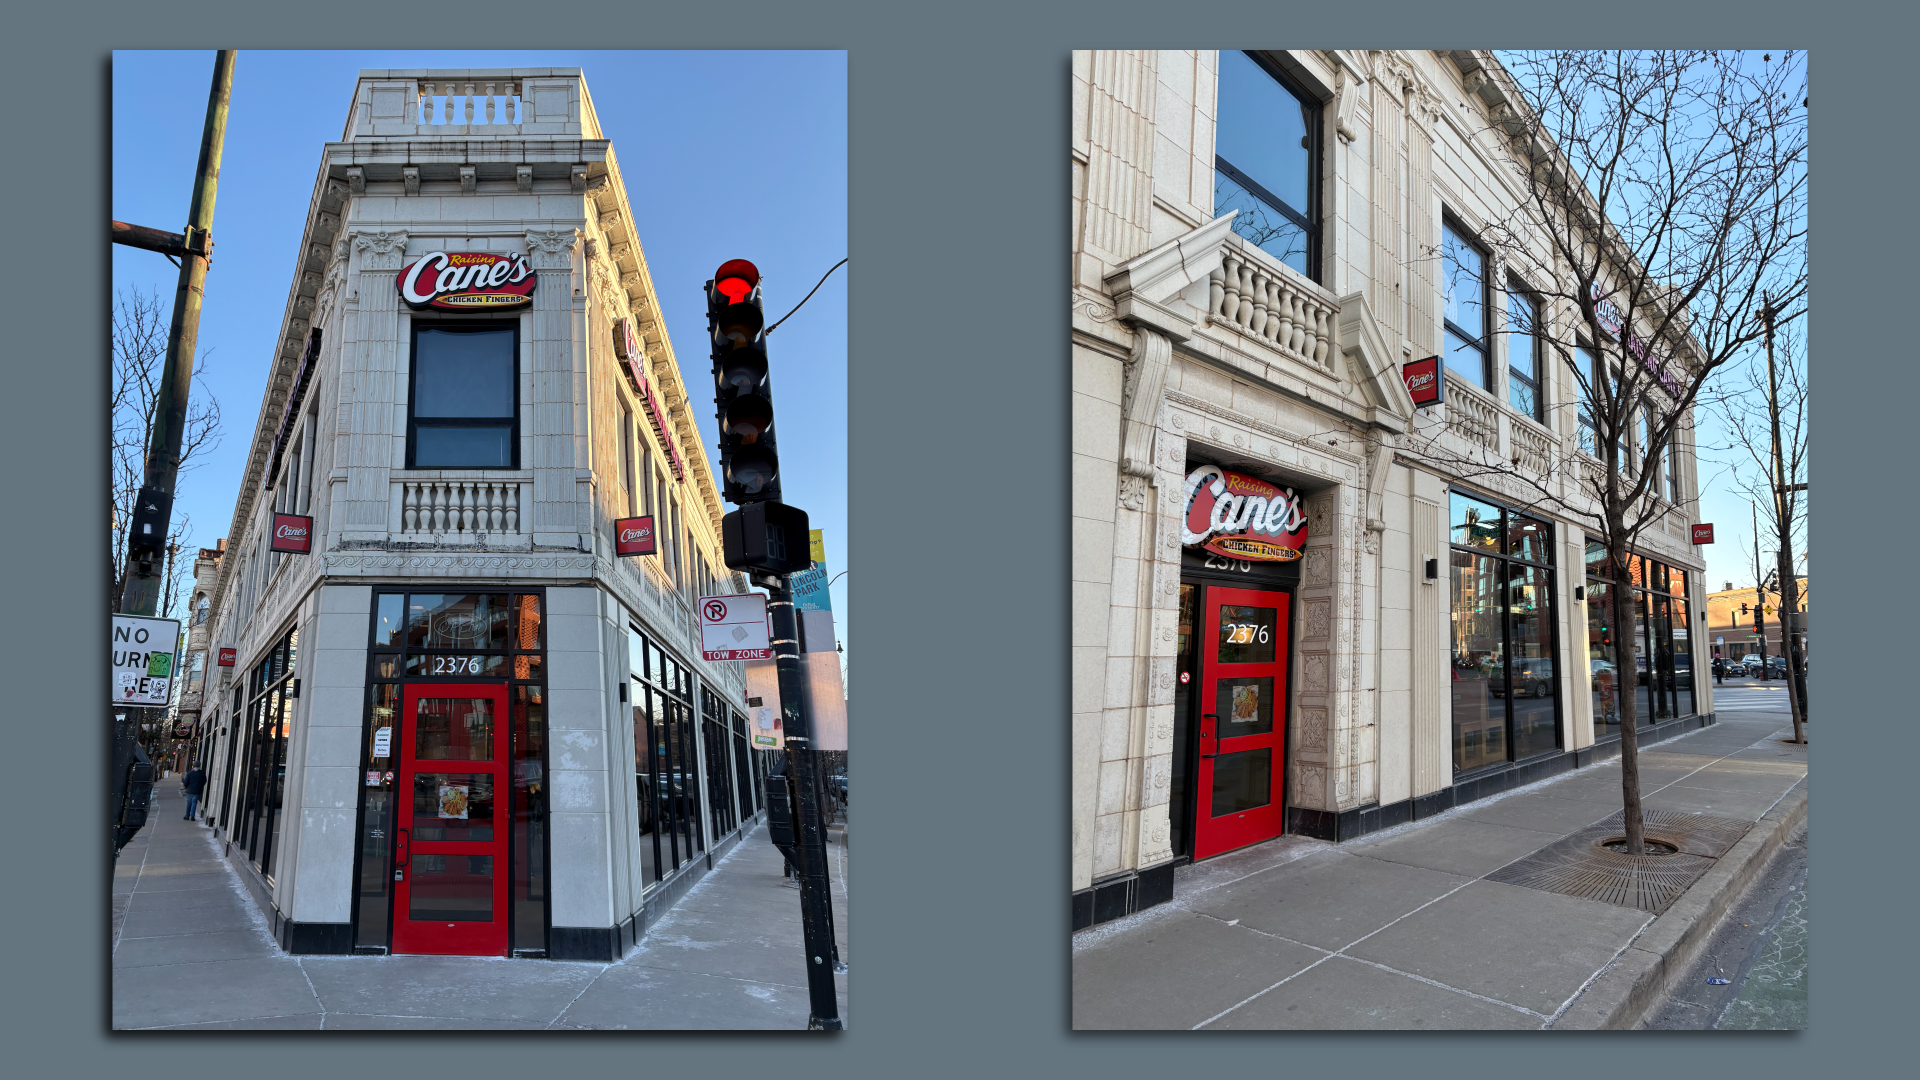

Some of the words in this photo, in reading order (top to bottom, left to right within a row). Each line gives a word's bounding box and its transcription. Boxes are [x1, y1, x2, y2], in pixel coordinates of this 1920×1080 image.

[450, 254, 496, 266] Raising
[402, 251, 535, 304] Cane's
[447, 295, 483, 303] CHICKEN
[485, 295, 522, 303] FINGERS
[1228, 474, 1274, 500] Raising
[1181, 464, 1308, 545] Cane's
[276, 525, 307, 538] Cane's
[620, 526, 652, 544] Cane's
[1222, 539, 1260, 555] CHICKEN
[1261, 545, 1296, 560] FINGERS
[791, 568, 828, 589] LINCOLN
[795, 581, 820, 598] PARK
[114, 626, 149, 644] NO
[1226, 623, 1269, 644] 2376
[707, 651, 730, 660] TOW
[735, 649, 766, 659] ZONE
[435, 657, 479, 673] 2376
